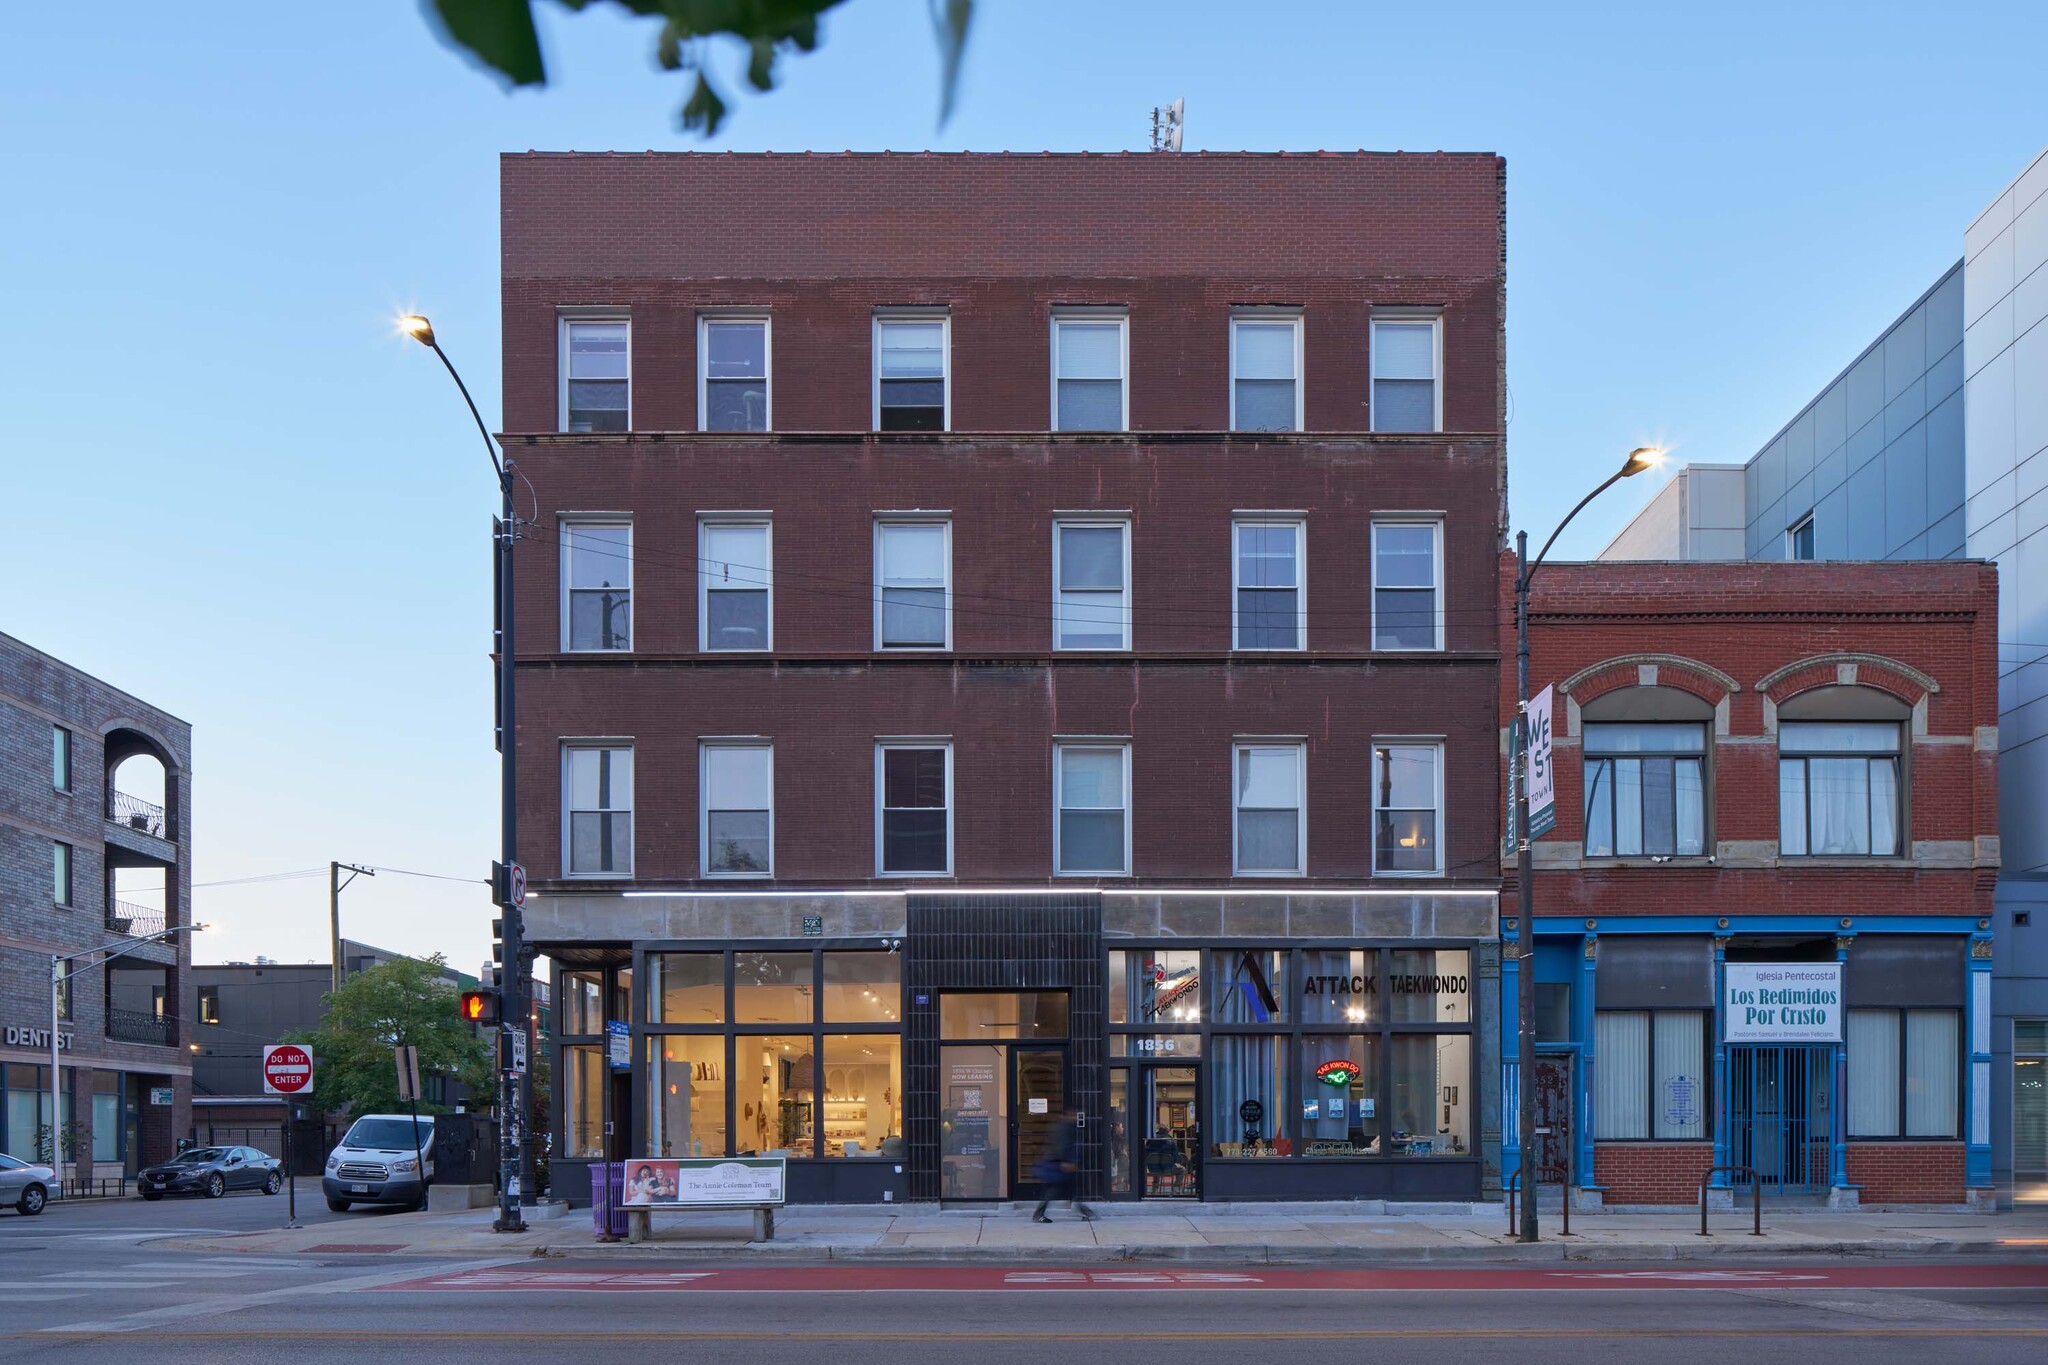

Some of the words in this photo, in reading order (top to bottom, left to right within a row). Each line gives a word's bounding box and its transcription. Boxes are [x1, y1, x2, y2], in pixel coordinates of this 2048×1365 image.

[1531, 788, 1548, 804] TOWN
[1756, 972, 1783, 982] Iglesia
[1785, 971, 1836, 980] Pentecostal
[1304, 976, 1376, 994] ATTACK
[1390, 975, 1467, 993] TAEKWONDO
[1156, 981, 1199, 1016] TAEKWONDO
[1158, 987, 1181, 1005] ATTACK
[1731, 988, 1754, 1004] Los
[1759, 988, 1837, 1004] Redimidos
[1745, 1007, 1775, 1025] Por
[1781, 1006, 1826, 1025] Cristo
[6, 1026, 74, 1049] DENTST
[515, 1033, 525, 1045] ONE
[515, 1046, 525, 1055] WAY
[1137, 1039, 1175, 1051] 1856
[271, 1055, 283, 1063] DO
[287, 1054, 305, 1063] NOT
[1317, 1064, 1331, 1074] TAE
[1330, 1061, 1349, 1069] KWON
[1349, 1064, 1360, 1073] DO
[275, 1075, 302, 1084] ENTER
